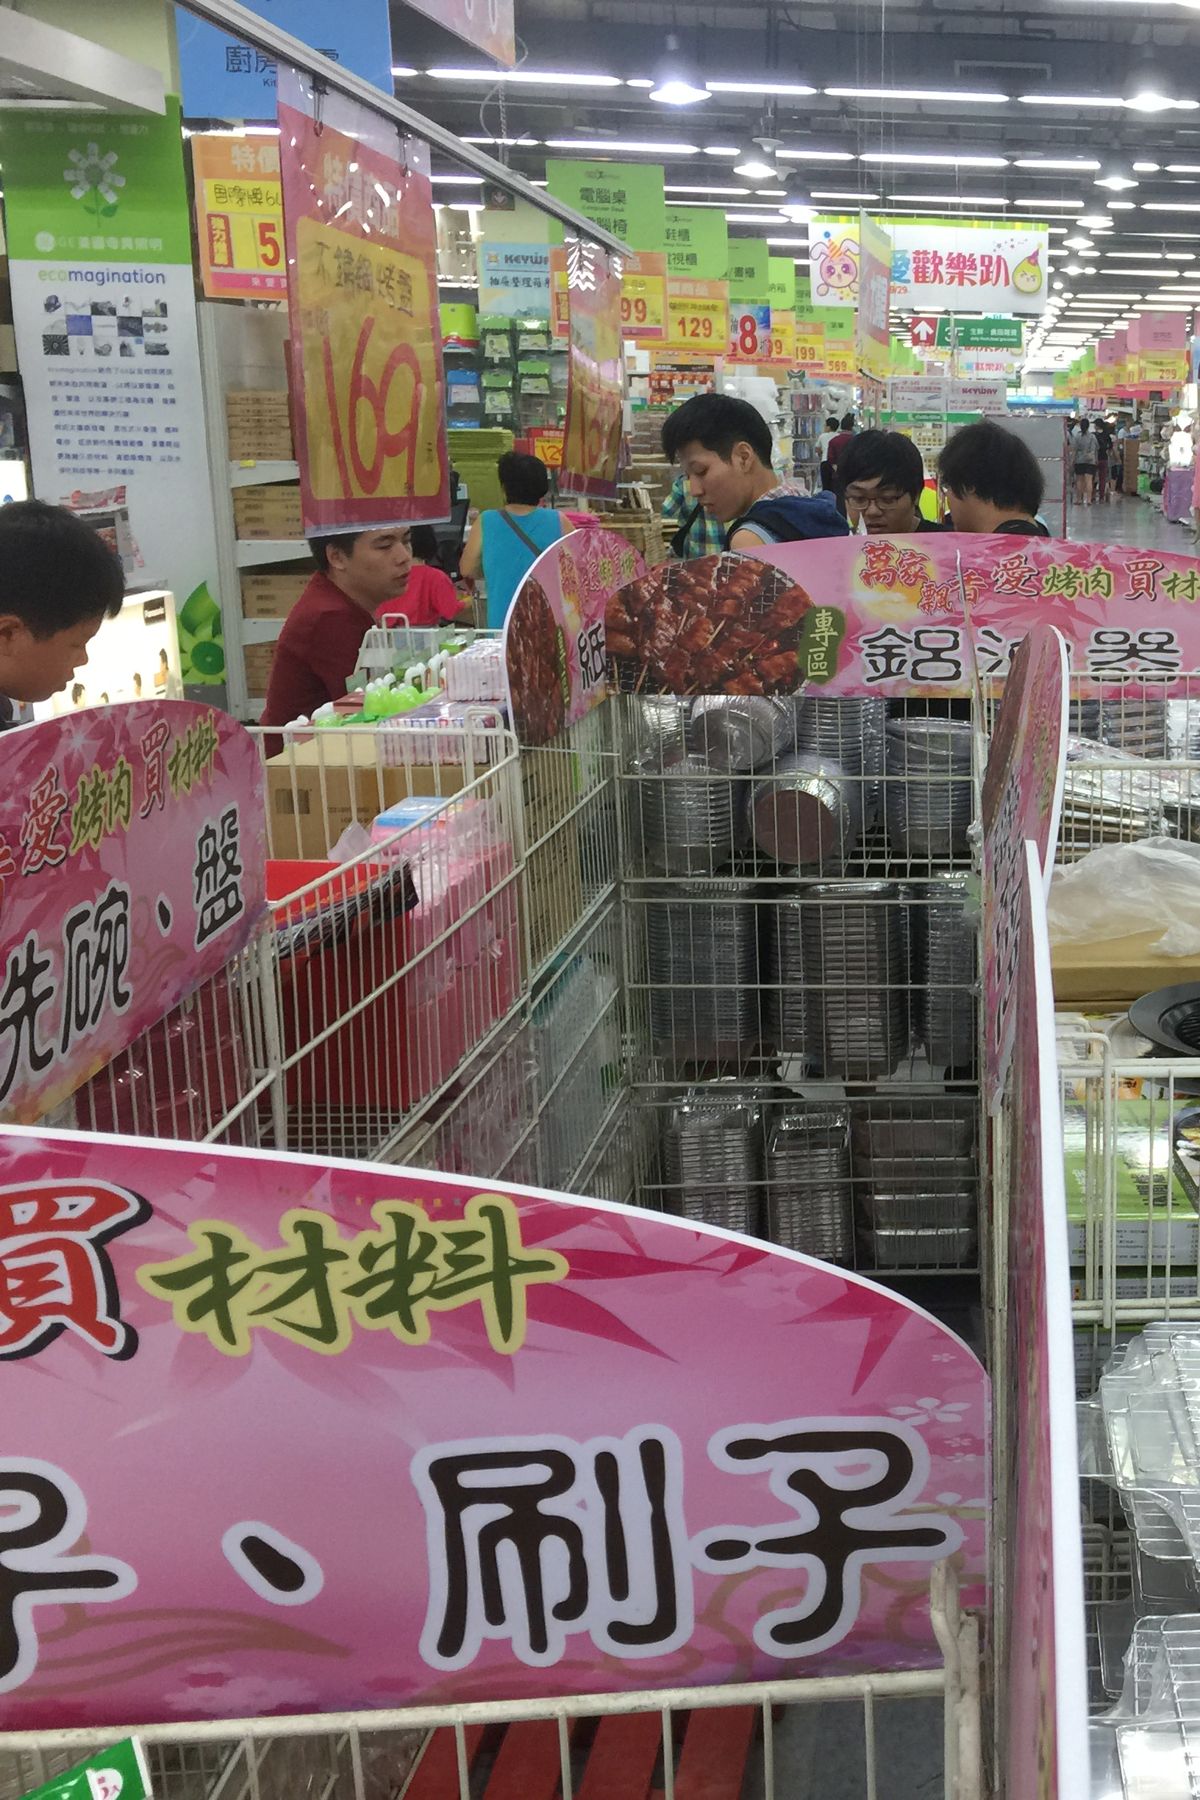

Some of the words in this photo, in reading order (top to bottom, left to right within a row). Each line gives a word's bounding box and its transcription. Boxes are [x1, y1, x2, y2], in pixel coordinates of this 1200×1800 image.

[38, 268, 166, 286] ecomagination
[678, 317, 712, 338] 129
[807, 608, 840, 679] 專區
